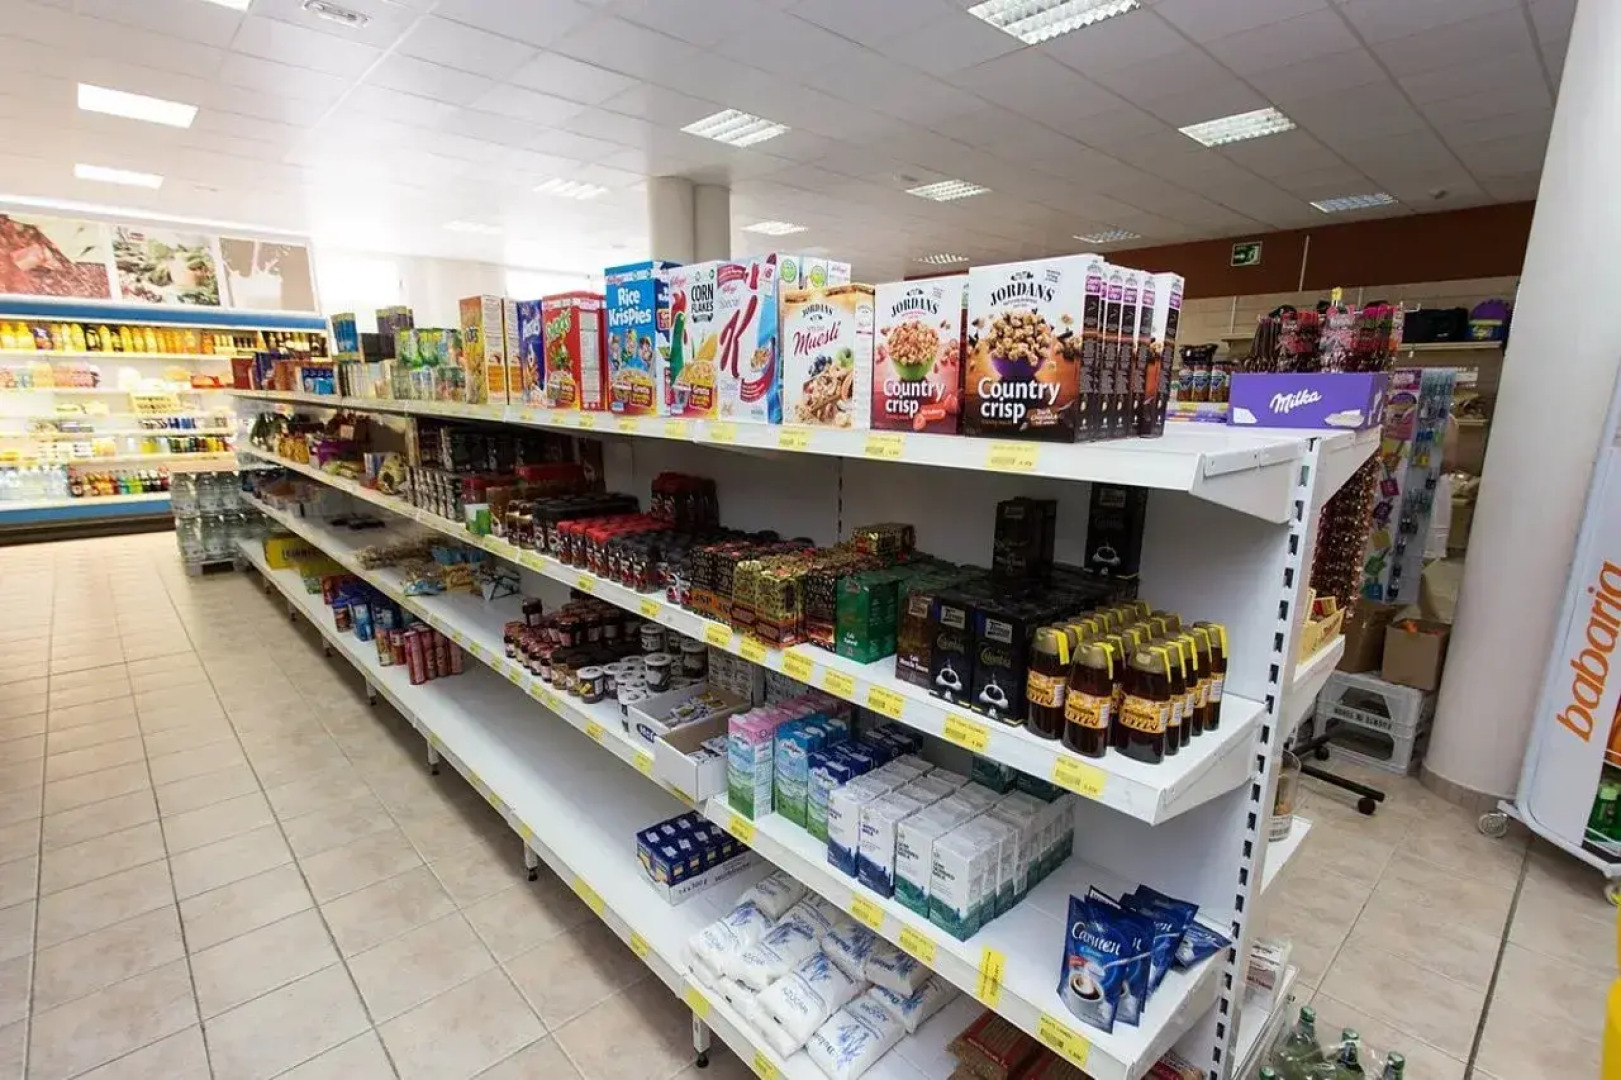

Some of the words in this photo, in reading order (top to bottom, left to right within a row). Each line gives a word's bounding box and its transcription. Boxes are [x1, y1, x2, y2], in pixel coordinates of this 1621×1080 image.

[617, 287, 640, 306] Rice
[691, 283, 714, 302] CORN
[990, 282, 1055, 307] JORDANS
[608, 308, 651, 327] Krispies
[691, 302, 714, 313] FLAKES
[801, 304, 834, 318] JORDANS
[891, 297, 939, 318] JORDANS
[793, 321, 842, 356] Muesli
[883, 378, 946, 403] Country
[977, 376, 1061, 406] Country
[1269, 388, 1323, 414] Milka
[885, 395, 920, 419] crisp
[980, 397, 1027, 424] crisp
[1556, 560, 1621, 743] babaria
